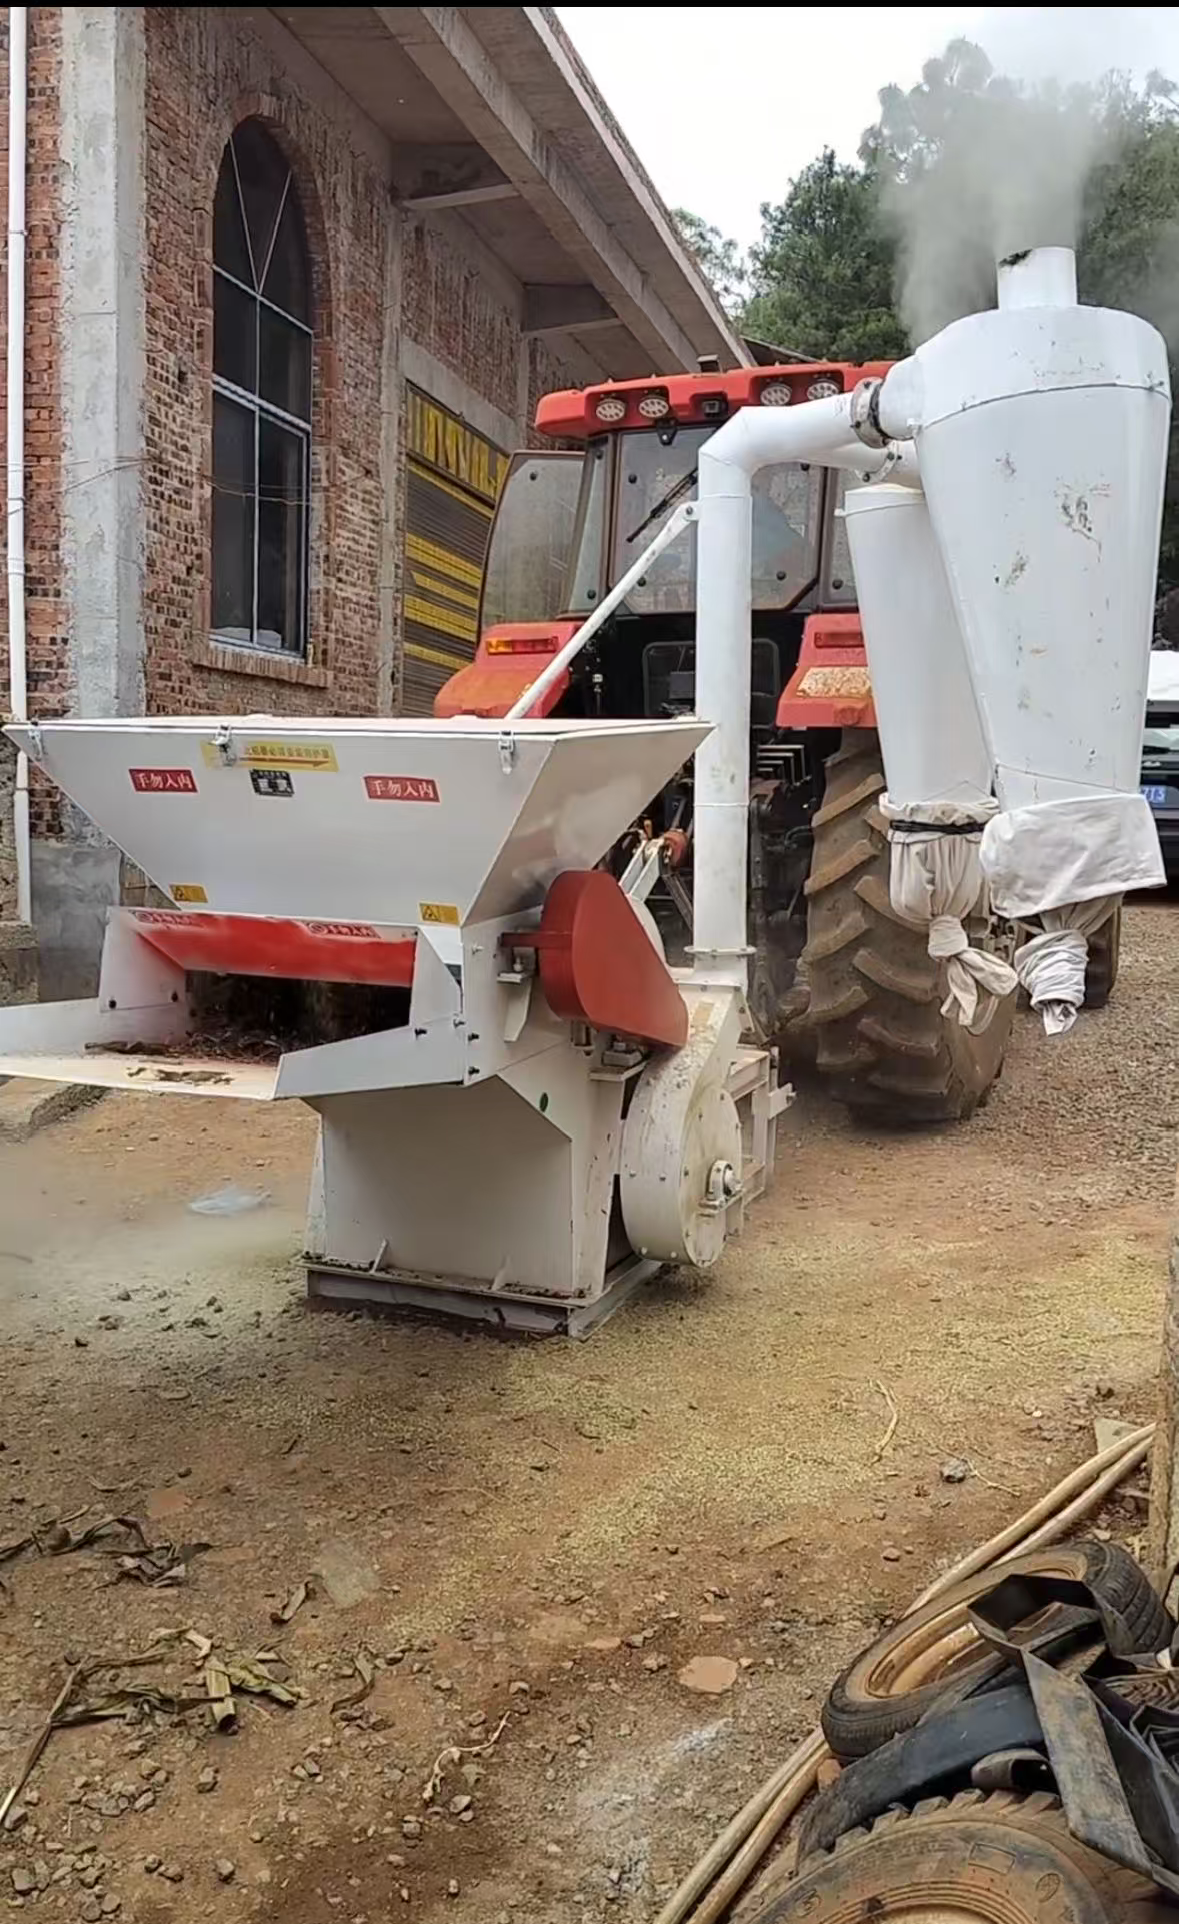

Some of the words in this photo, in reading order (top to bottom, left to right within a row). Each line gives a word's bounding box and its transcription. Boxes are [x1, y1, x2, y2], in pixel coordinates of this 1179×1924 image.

[135, 772, 193, 790] 手勿入内
[372, 779, 435, 798] 手勿入内
